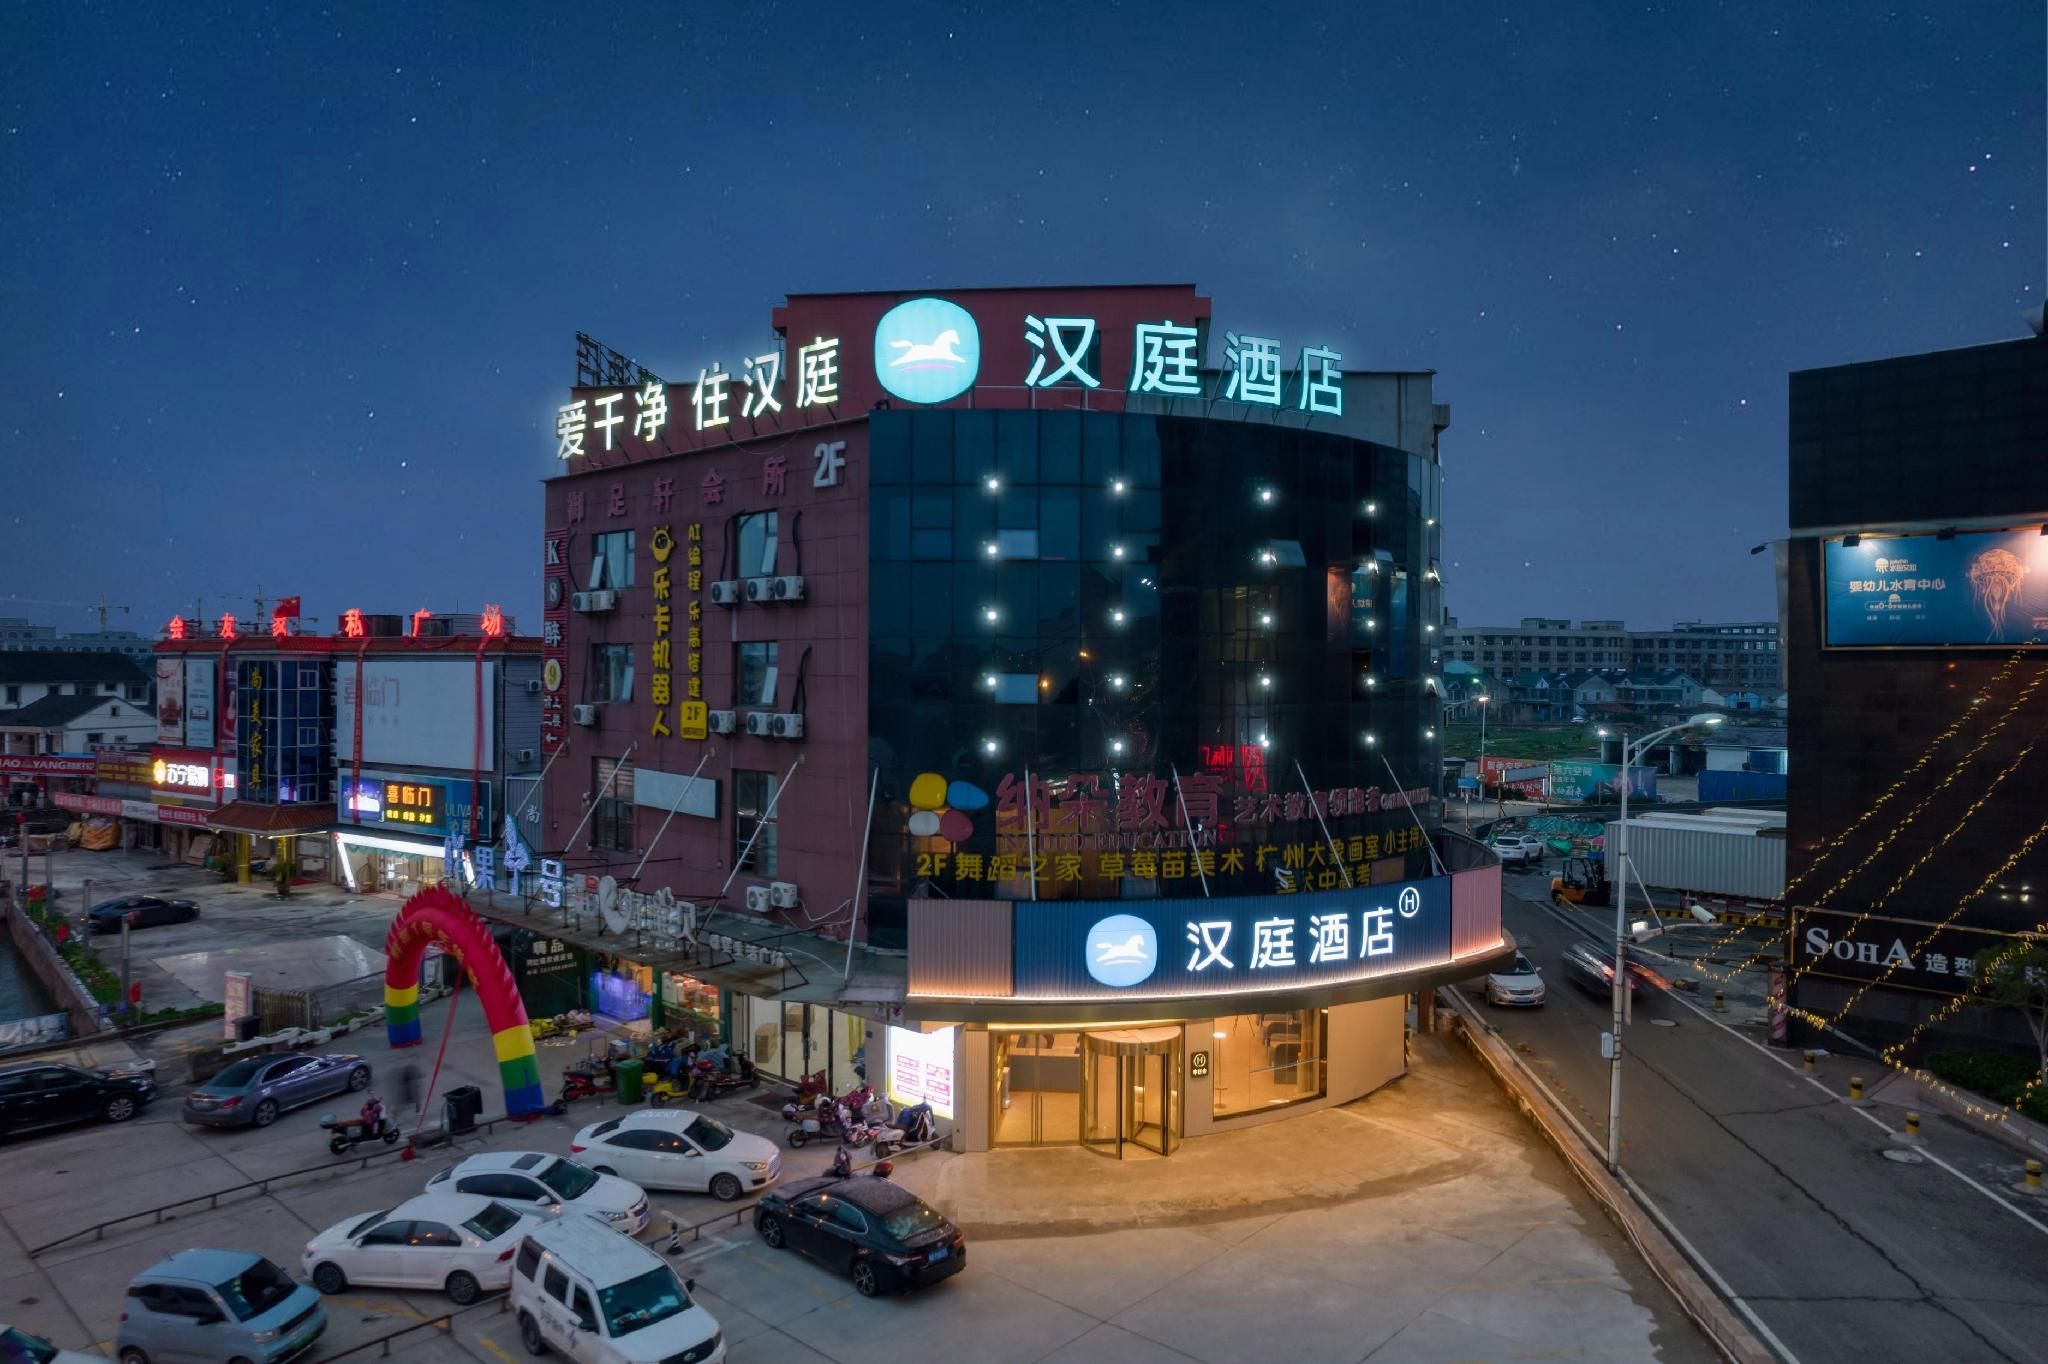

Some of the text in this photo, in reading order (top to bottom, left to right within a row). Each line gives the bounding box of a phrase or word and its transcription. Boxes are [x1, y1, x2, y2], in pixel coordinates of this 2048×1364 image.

[1025, 314, 1342, 416] 汉庭酒店
[557, 380, 667, 461] 爱干净
[691, 336, 839, 431] 住汉庭
[812, 441, 847, 489] 2F
[1850, 578, 1946, 592] 婴幼儿水育中心
[652, 566, 671, 738] 乐卡机器人
[386, 785, 432, 806] 喜临门
[995, 771, 1224, 830] 纳朵教育
[917, 853, 947, 877] 2F
[955, 853, 1083, 882] 舞蹈之家
[1099, 847, 1244, 881] 草莓苗美术
[1187, 906, 1393, 971] 汉庭酒店
